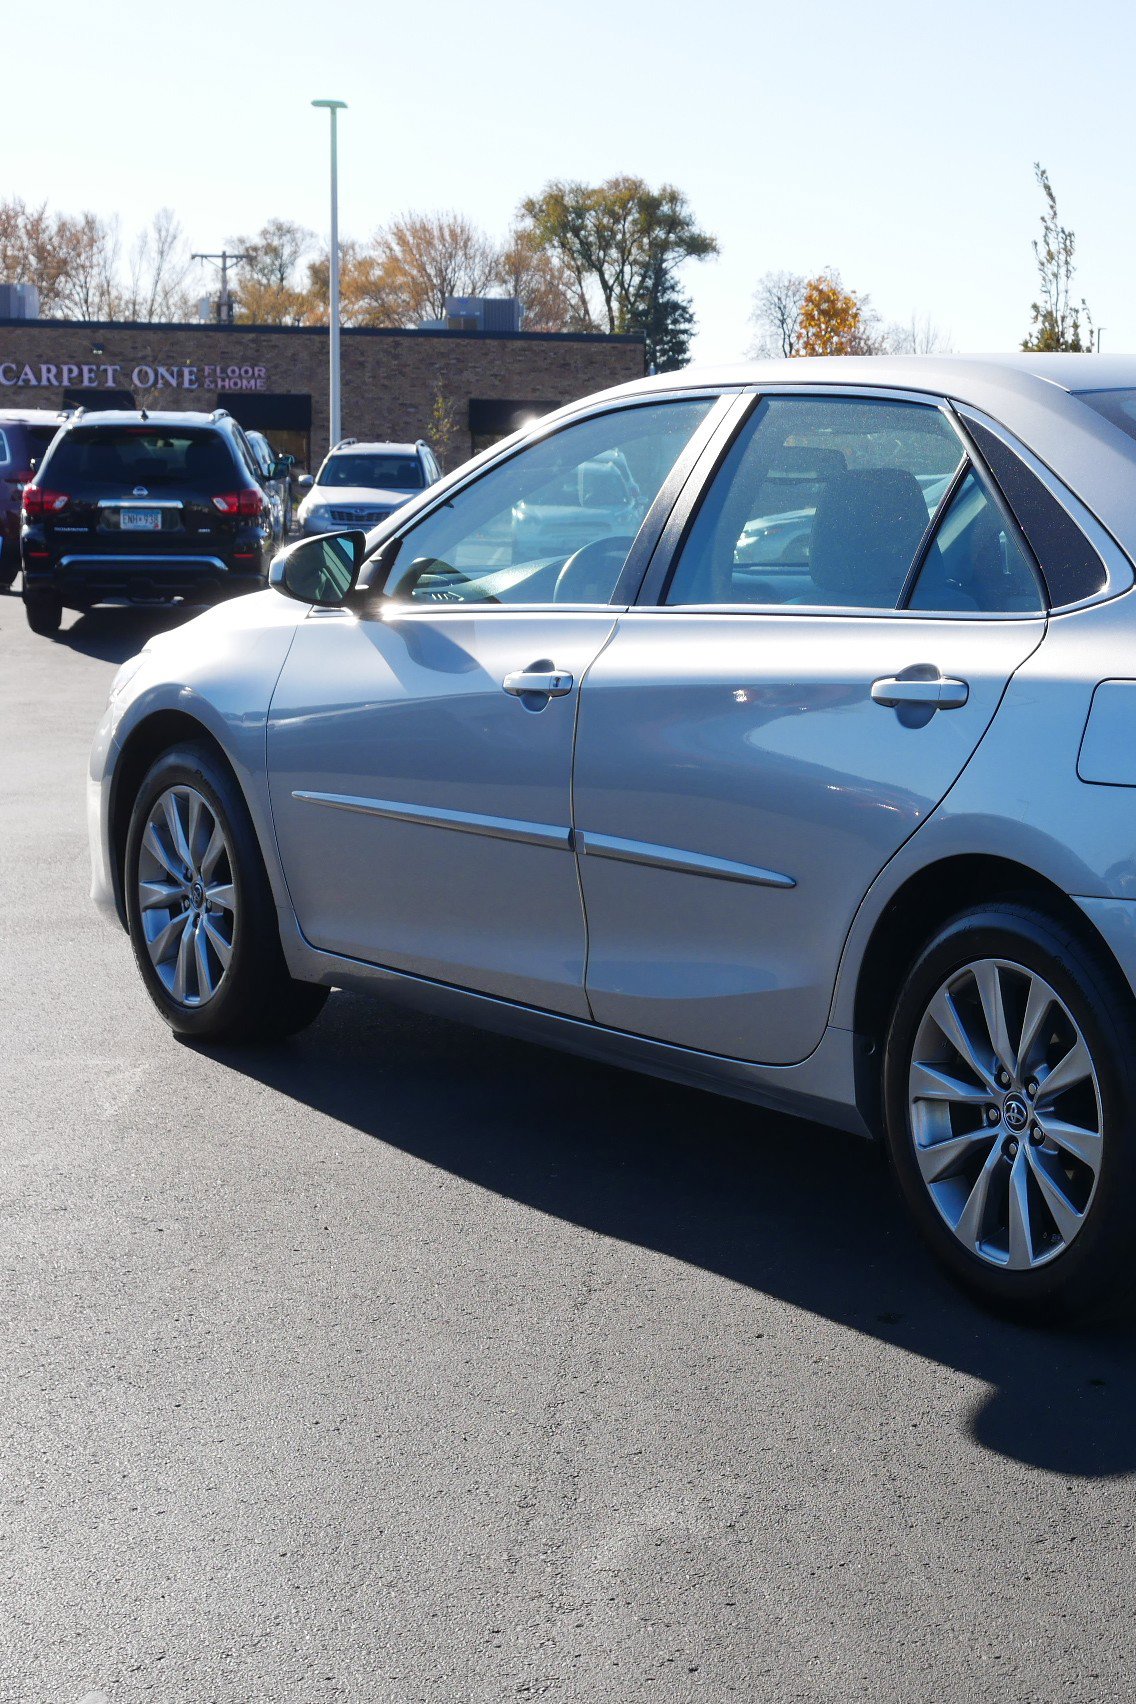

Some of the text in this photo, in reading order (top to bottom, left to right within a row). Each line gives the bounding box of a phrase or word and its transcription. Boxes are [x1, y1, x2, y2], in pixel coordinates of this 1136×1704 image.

[0, 363, 199, 389] CARPET ONE
[204, 365, 266, 378] FLOOR
